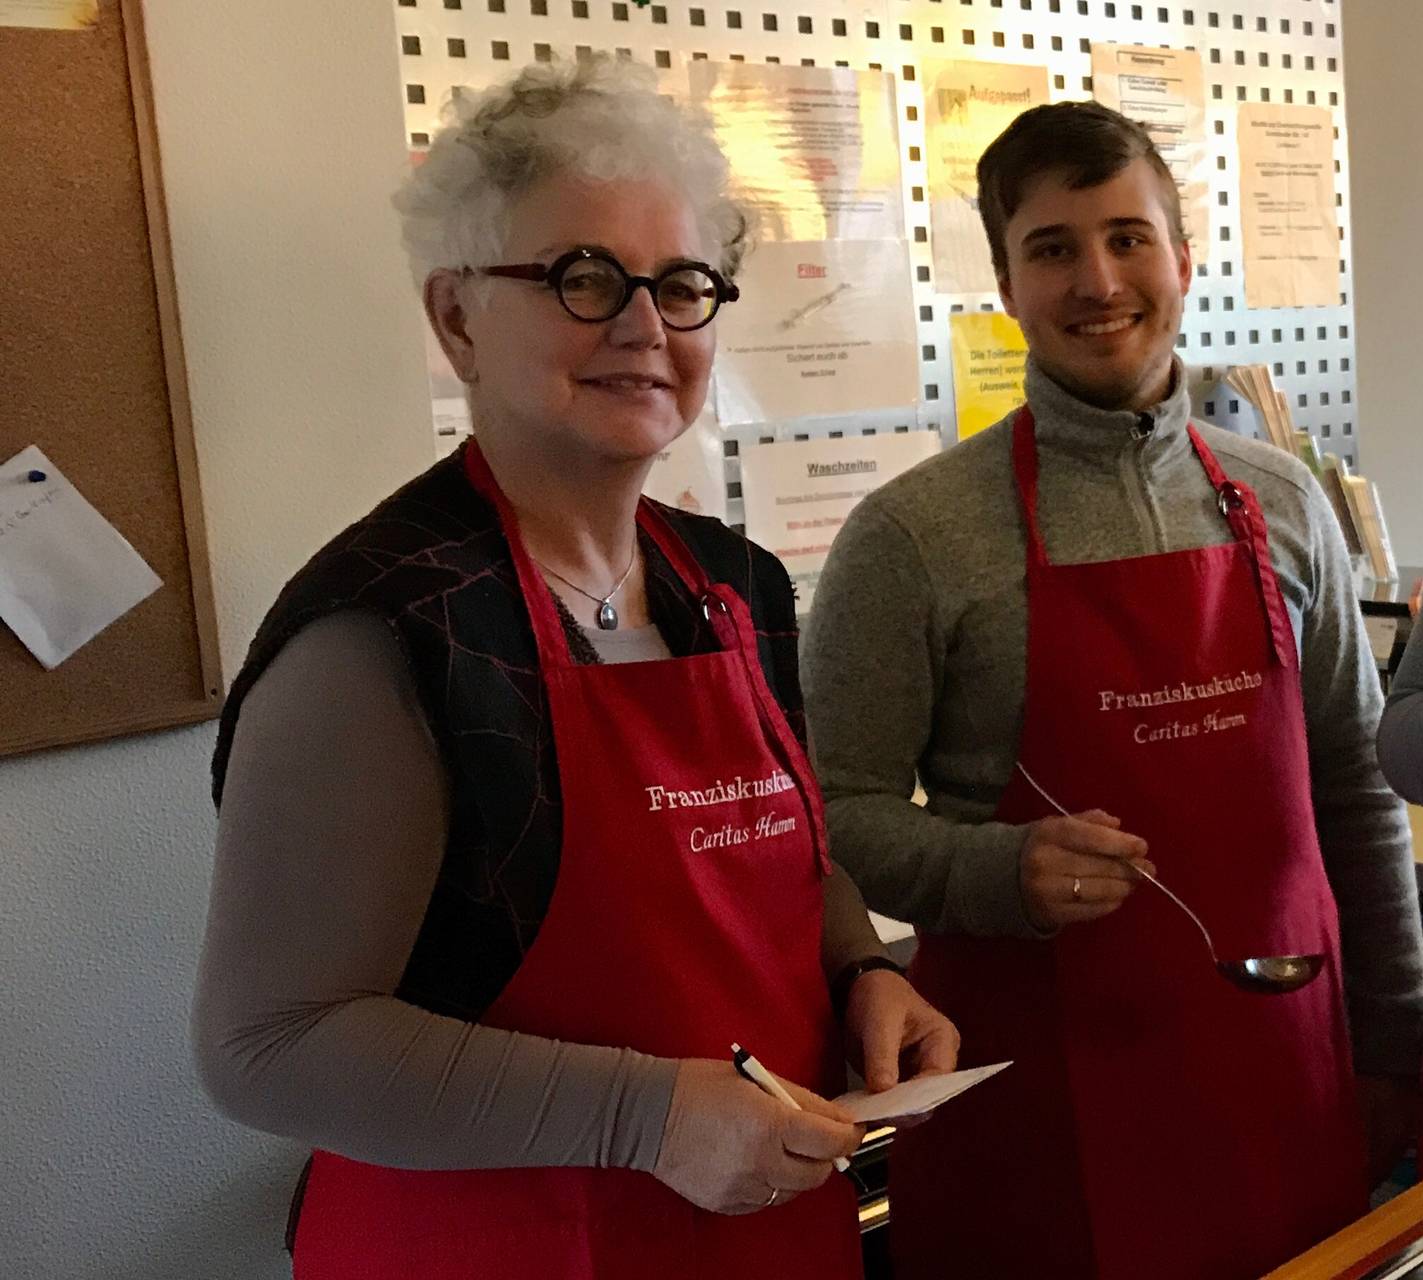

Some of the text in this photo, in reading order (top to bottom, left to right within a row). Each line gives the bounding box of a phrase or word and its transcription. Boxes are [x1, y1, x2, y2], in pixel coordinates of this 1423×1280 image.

[807, 459, 877, 476] Waschzeiten
[1098, 671, 1263, 711] Franziskusküche
[1134, 709, 1247, 744] Caritas Hamm
[645, 769, 796, 811] Franziskuskü
[691, 811, 796, 852] Caritas Hamm
